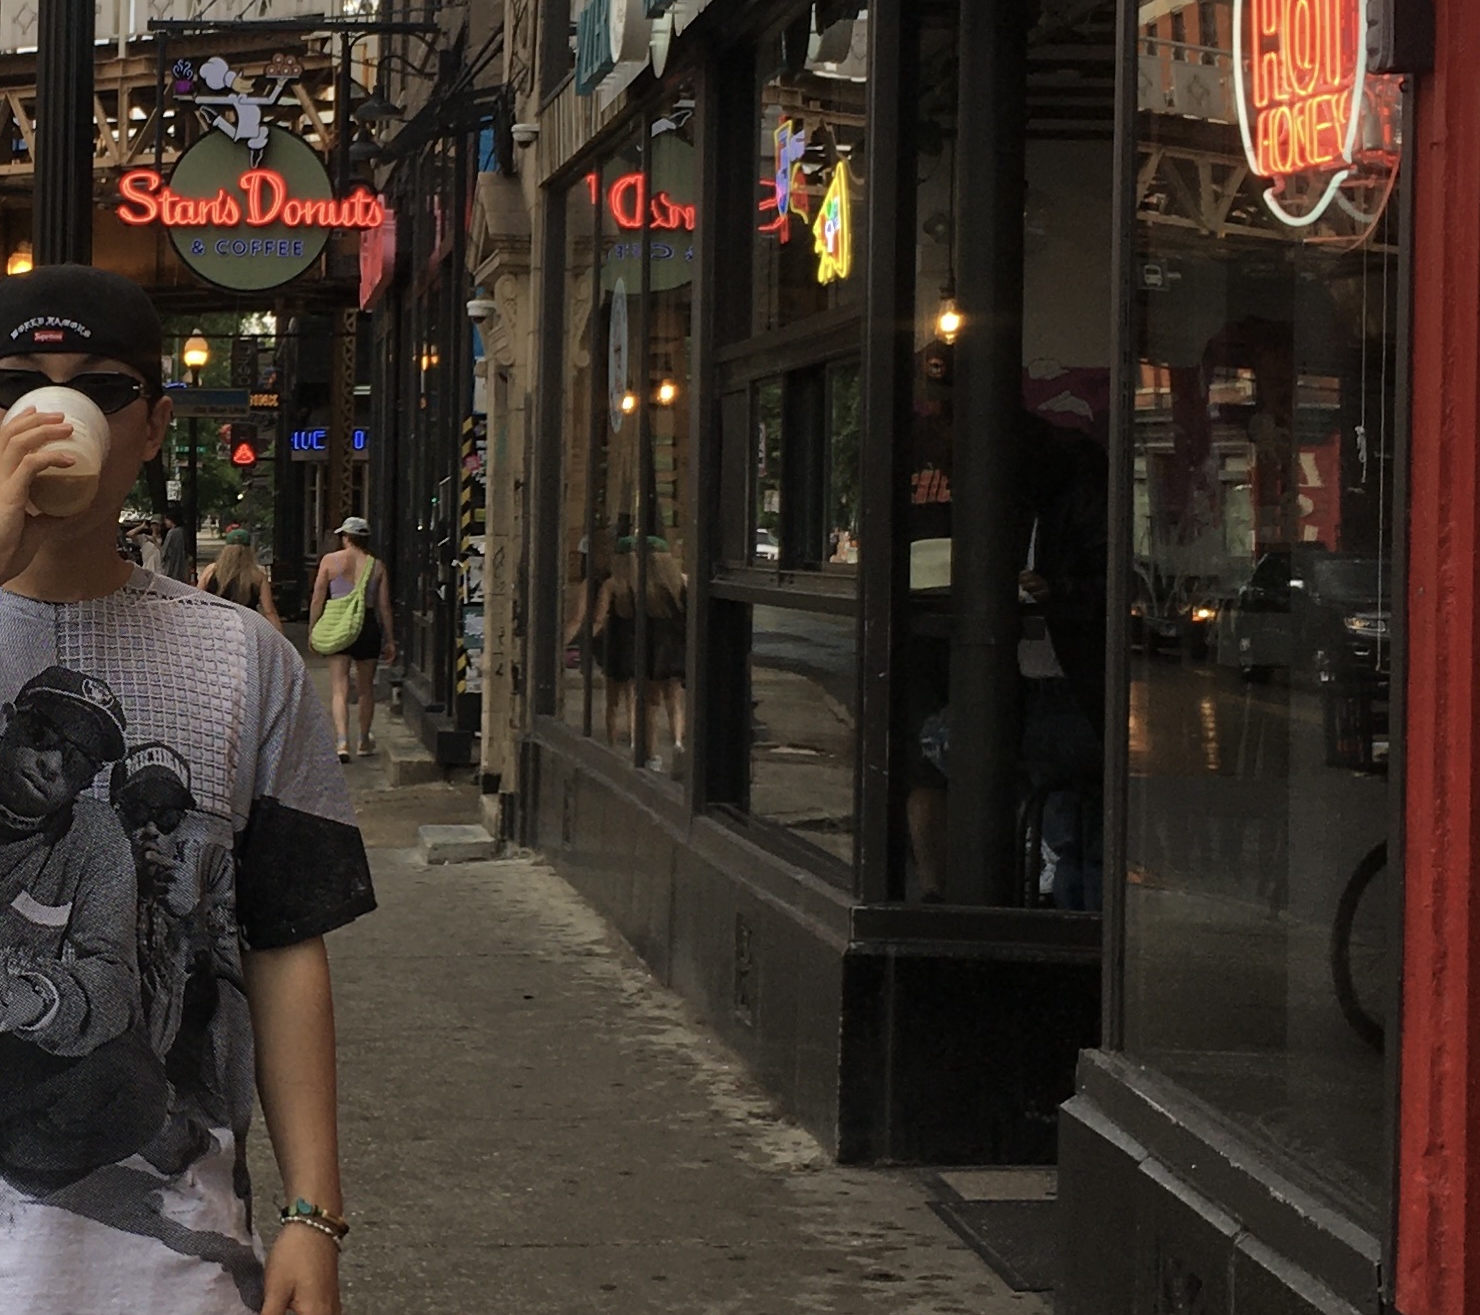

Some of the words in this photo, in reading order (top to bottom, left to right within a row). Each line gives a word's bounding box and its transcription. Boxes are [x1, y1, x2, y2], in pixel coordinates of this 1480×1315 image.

[1255, 91, 1349, 177] HONEY
[118, 169, 241, 227] Stan's
[238, 169, 385, 228] Donuts
[191, 239, 206, 256] &
[215, 239, 304, 257] COFFEE
